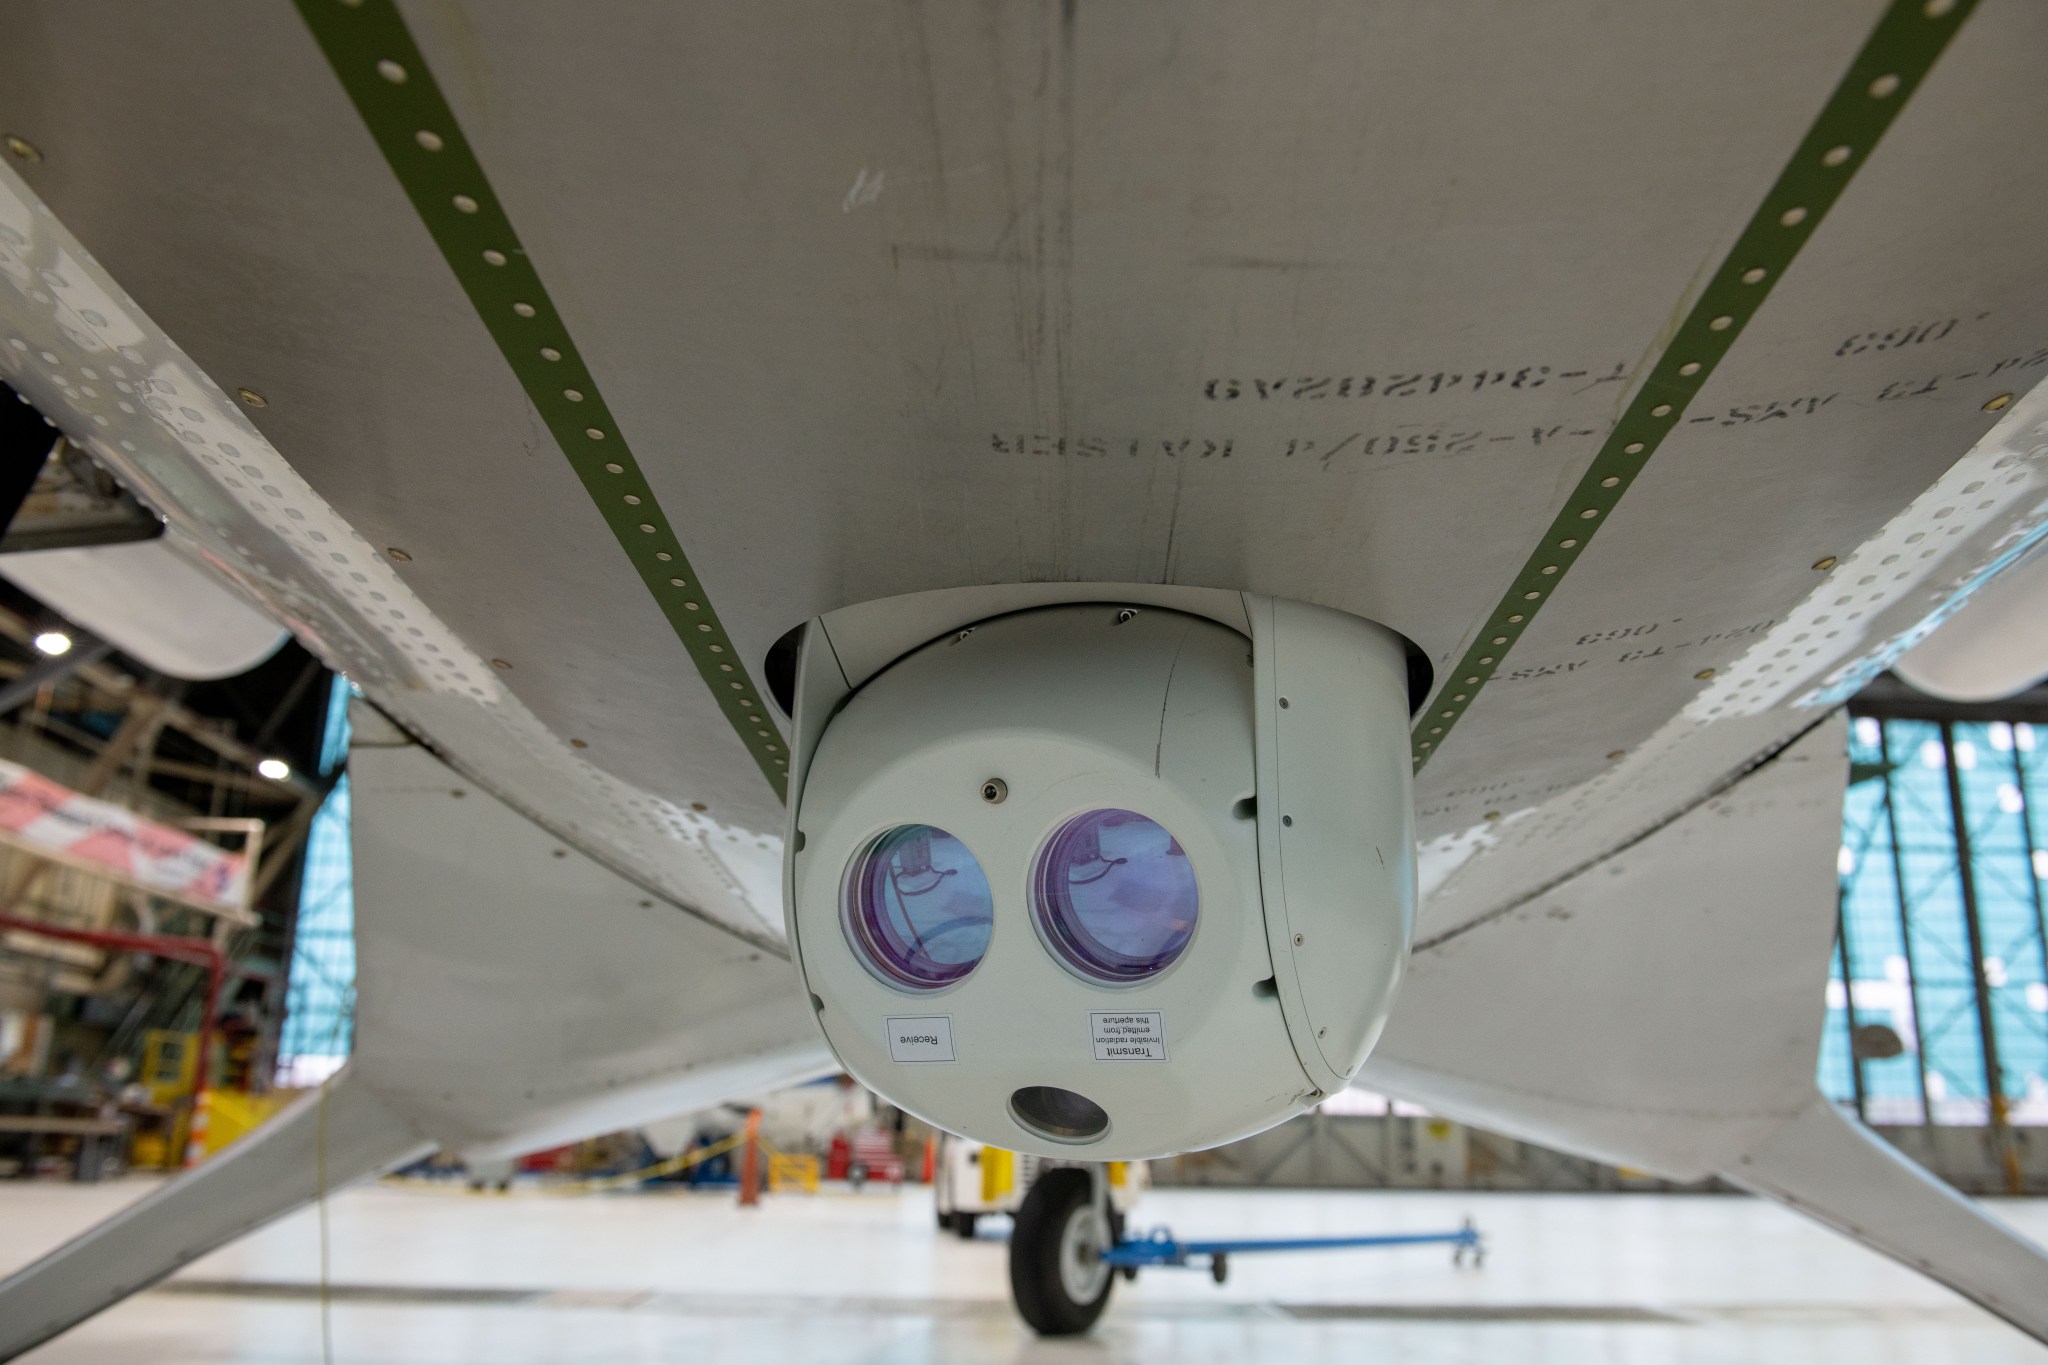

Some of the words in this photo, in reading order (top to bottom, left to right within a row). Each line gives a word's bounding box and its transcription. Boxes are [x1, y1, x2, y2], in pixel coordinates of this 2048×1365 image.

[1102, 1016, 1134, 1025] aperture
[1135, 1017, 1150, 1025] this
[1103, 1027, 1121, 1035] from
[1122, 1027, 1151, 1035] emitted
[900, 1035, 938, 1046] Receive
[1095, 1037, 1128, 1045] radiation
[1106, 1047, 1153, 1058] Transmit
